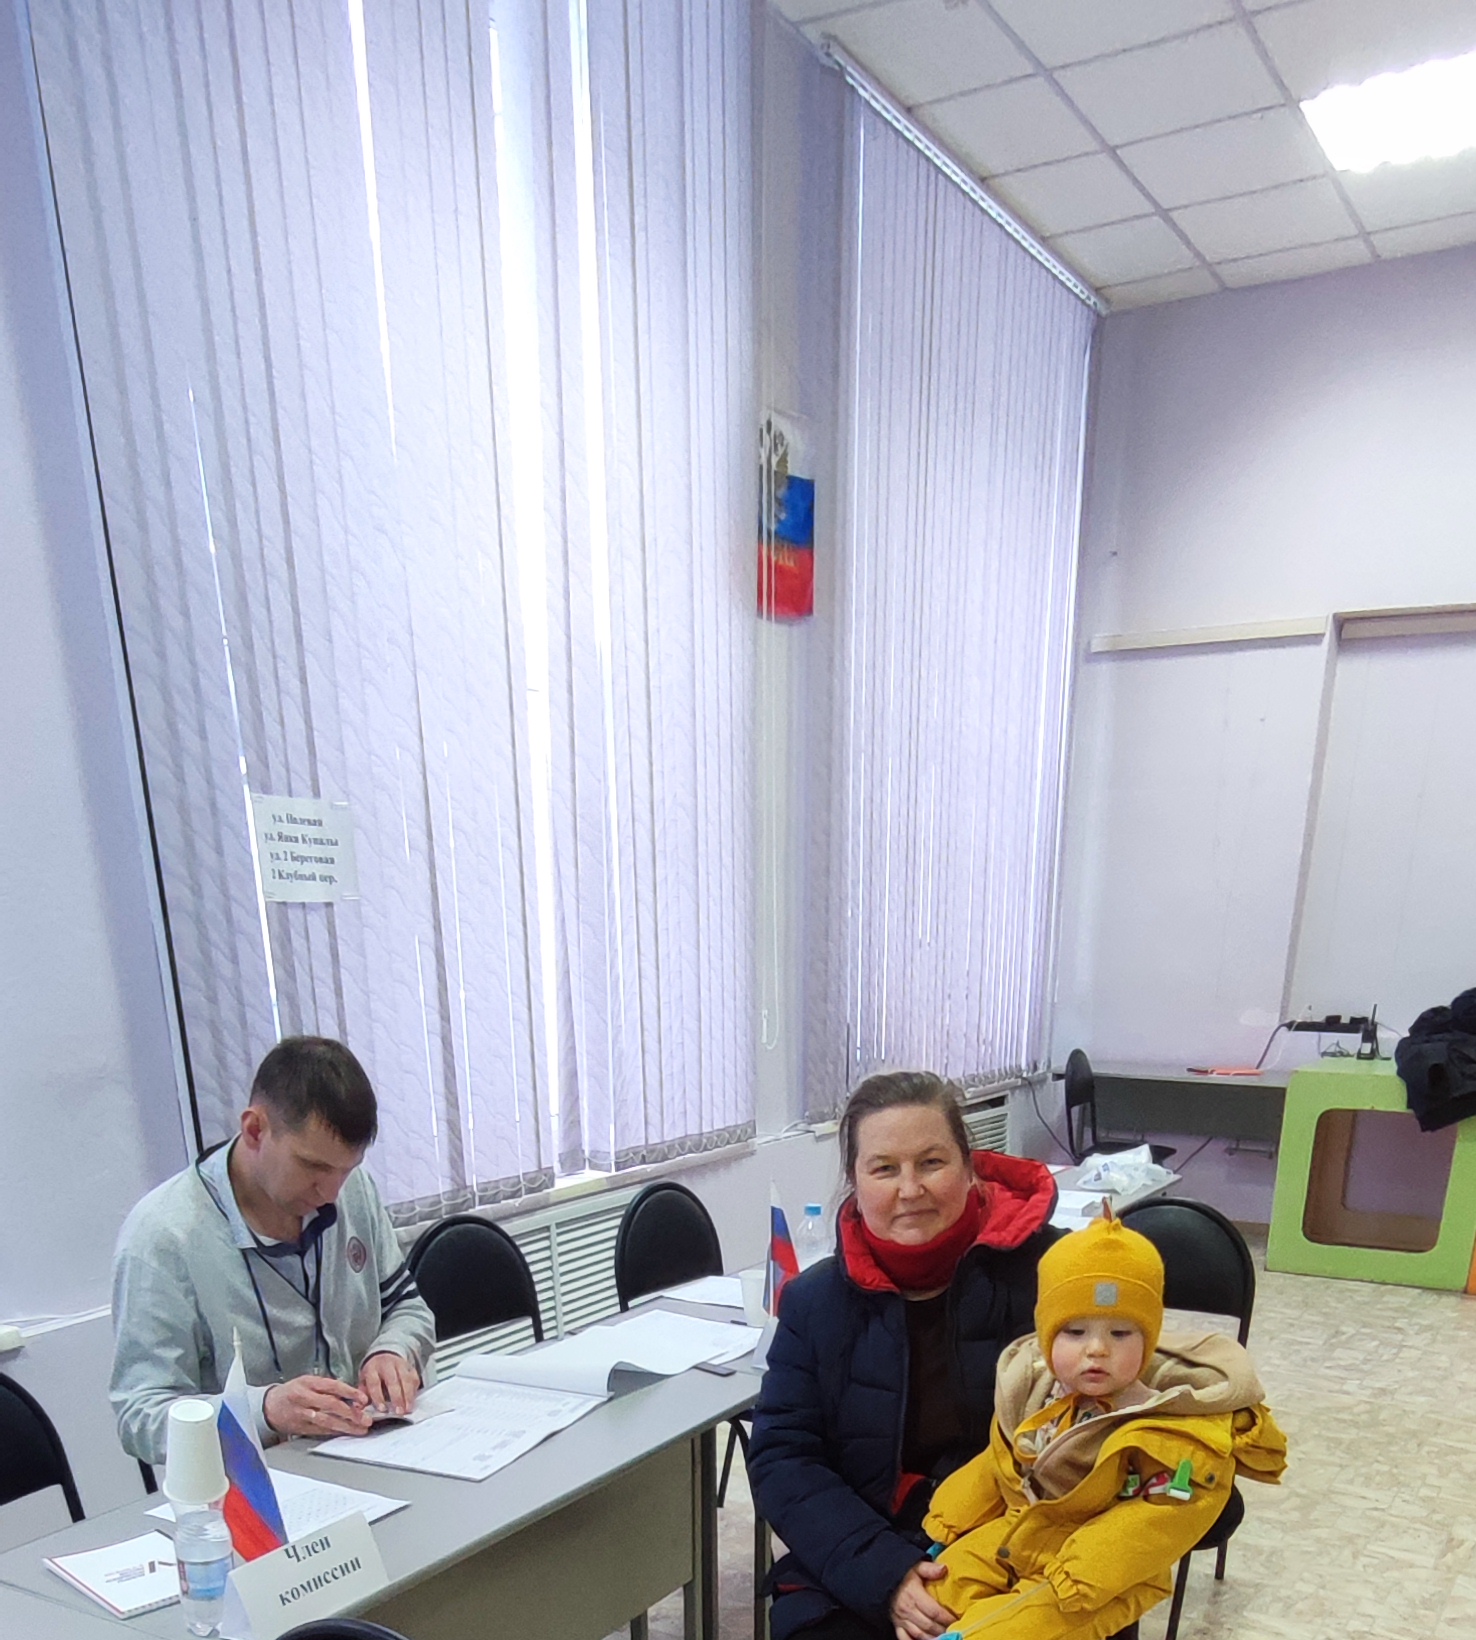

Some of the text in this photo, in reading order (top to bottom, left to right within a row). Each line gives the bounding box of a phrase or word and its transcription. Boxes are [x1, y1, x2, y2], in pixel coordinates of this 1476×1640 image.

[286, 813, 323, 827] Полевая
[277, 832, 299, 844] Янки
[301, 834, 339, 847] Купалы
[283, 851, 288, 861] 2
[290, 851, 335, 865] Береговая
[271, 869, 338, 885] 2 Клубный пер.
[284, 1536, 331, 1563] Член
[279, 1557, 362, 1606] комиссии
